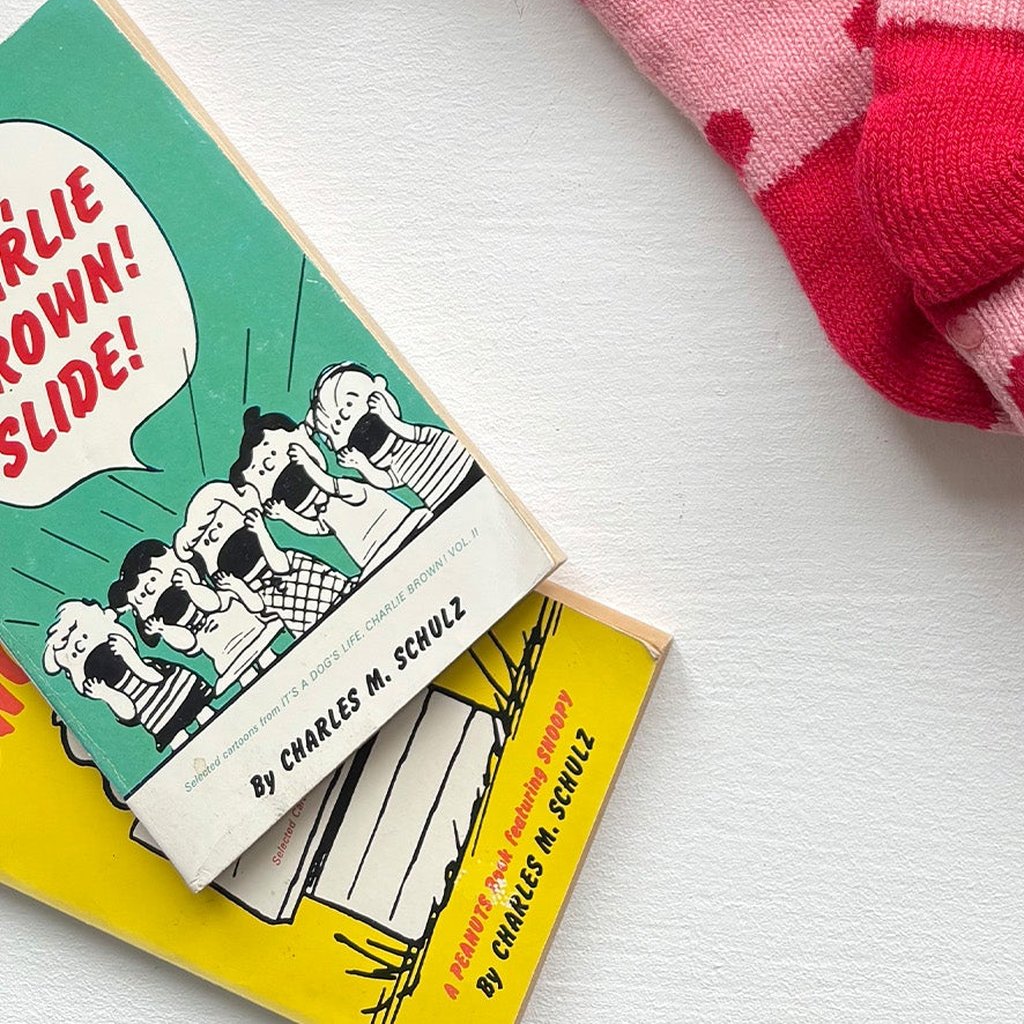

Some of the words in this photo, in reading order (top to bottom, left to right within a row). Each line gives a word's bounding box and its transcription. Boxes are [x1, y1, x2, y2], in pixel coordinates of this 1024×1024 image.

[0, 165, 103, 301] RLIE
[0, 316, 144, 478] SLIDE!
[184, 756, 221, 793] Selected
[223, 726, 259, 759] cartoons
[259, 707, 281, 727] from
[281, 688, 299, 708] IT'S
[301, 681, 309, 690] A
[309, 650, 341, 681] DOG'S
[365, 592, 407, 631] CHARLIE
[407, 554, 447, 594] BROWN!
[448, 539, 471, 557] VOL.
[250, 770, 275, 798] By
[280, 687, 362, 771] CHARLES
[365, 668, 392, 697] M.
[394, 596, 466, 671] SCHULZ
[537, 689, 573, 764] SNOOPY
[272, 820, 296, 865] Selected
[504, 766, 548, 846] featuring
[476, 967, 503, 998] By
[492, 854, 543, 960] CHARLES
[535, 827, 559, 855] M.
[549, 728, 595, 821] SCHULZ
[443, 983, 459, 1000] A
[450, 893, 492, 981] PEANUTS
